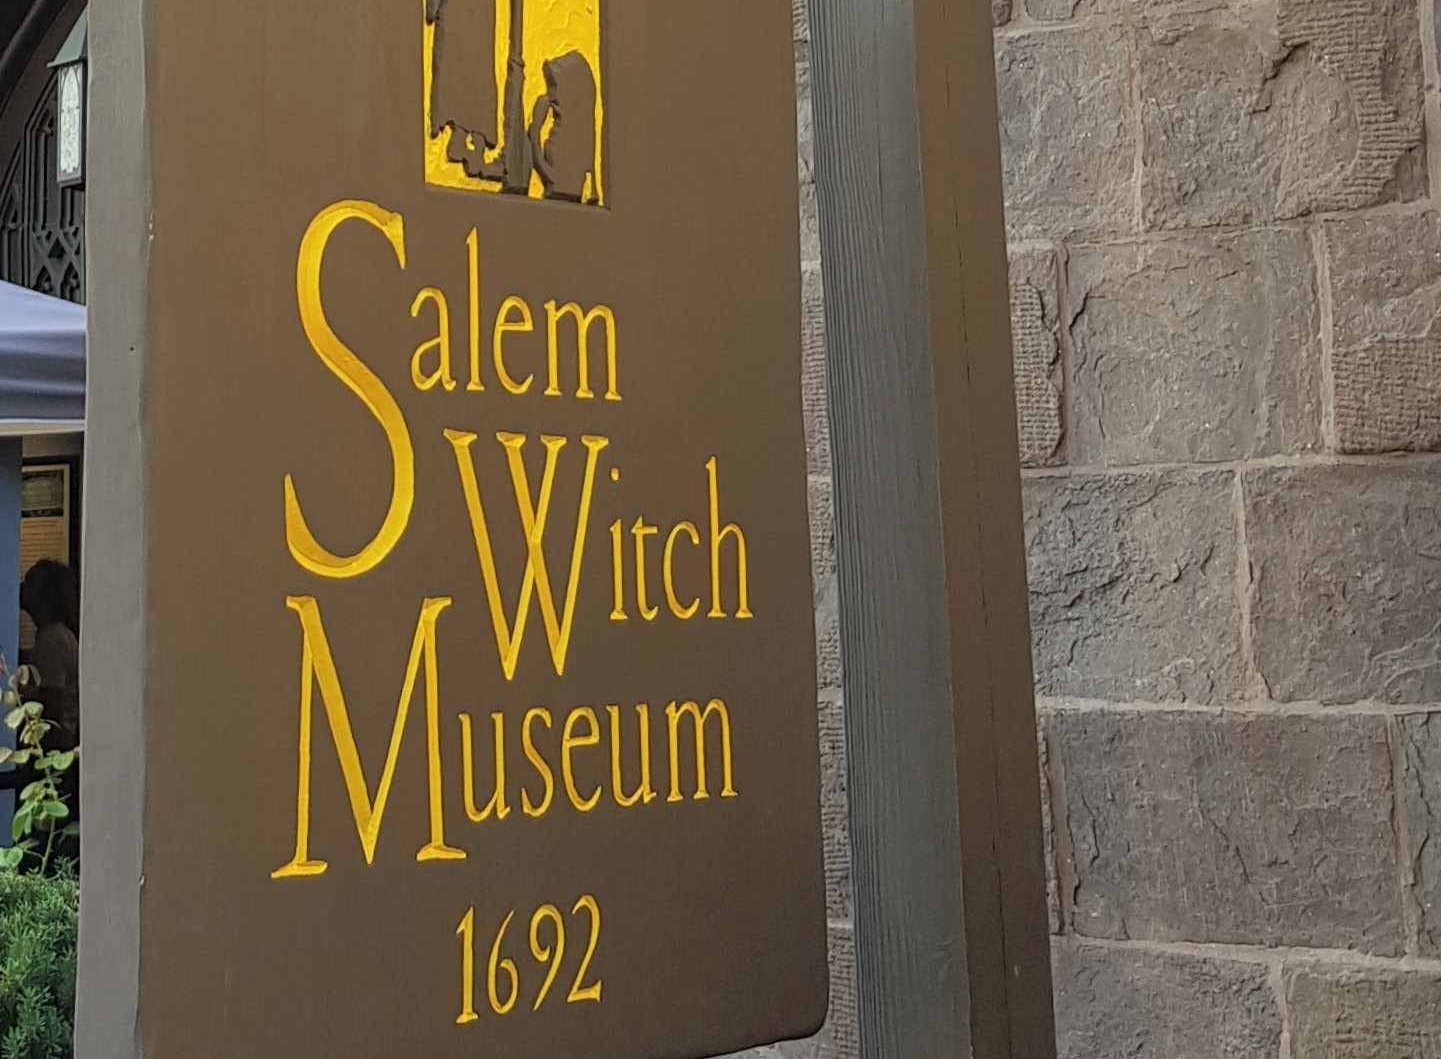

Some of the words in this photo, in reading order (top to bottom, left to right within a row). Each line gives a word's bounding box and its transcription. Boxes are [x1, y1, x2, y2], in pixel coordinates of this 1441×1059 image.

[284, 198, 623, 579] Salem
[443, 427, 754, 681] Witch
[271, 595, 740, 880] Museum
[456, 893, 604, 1025] 1692
